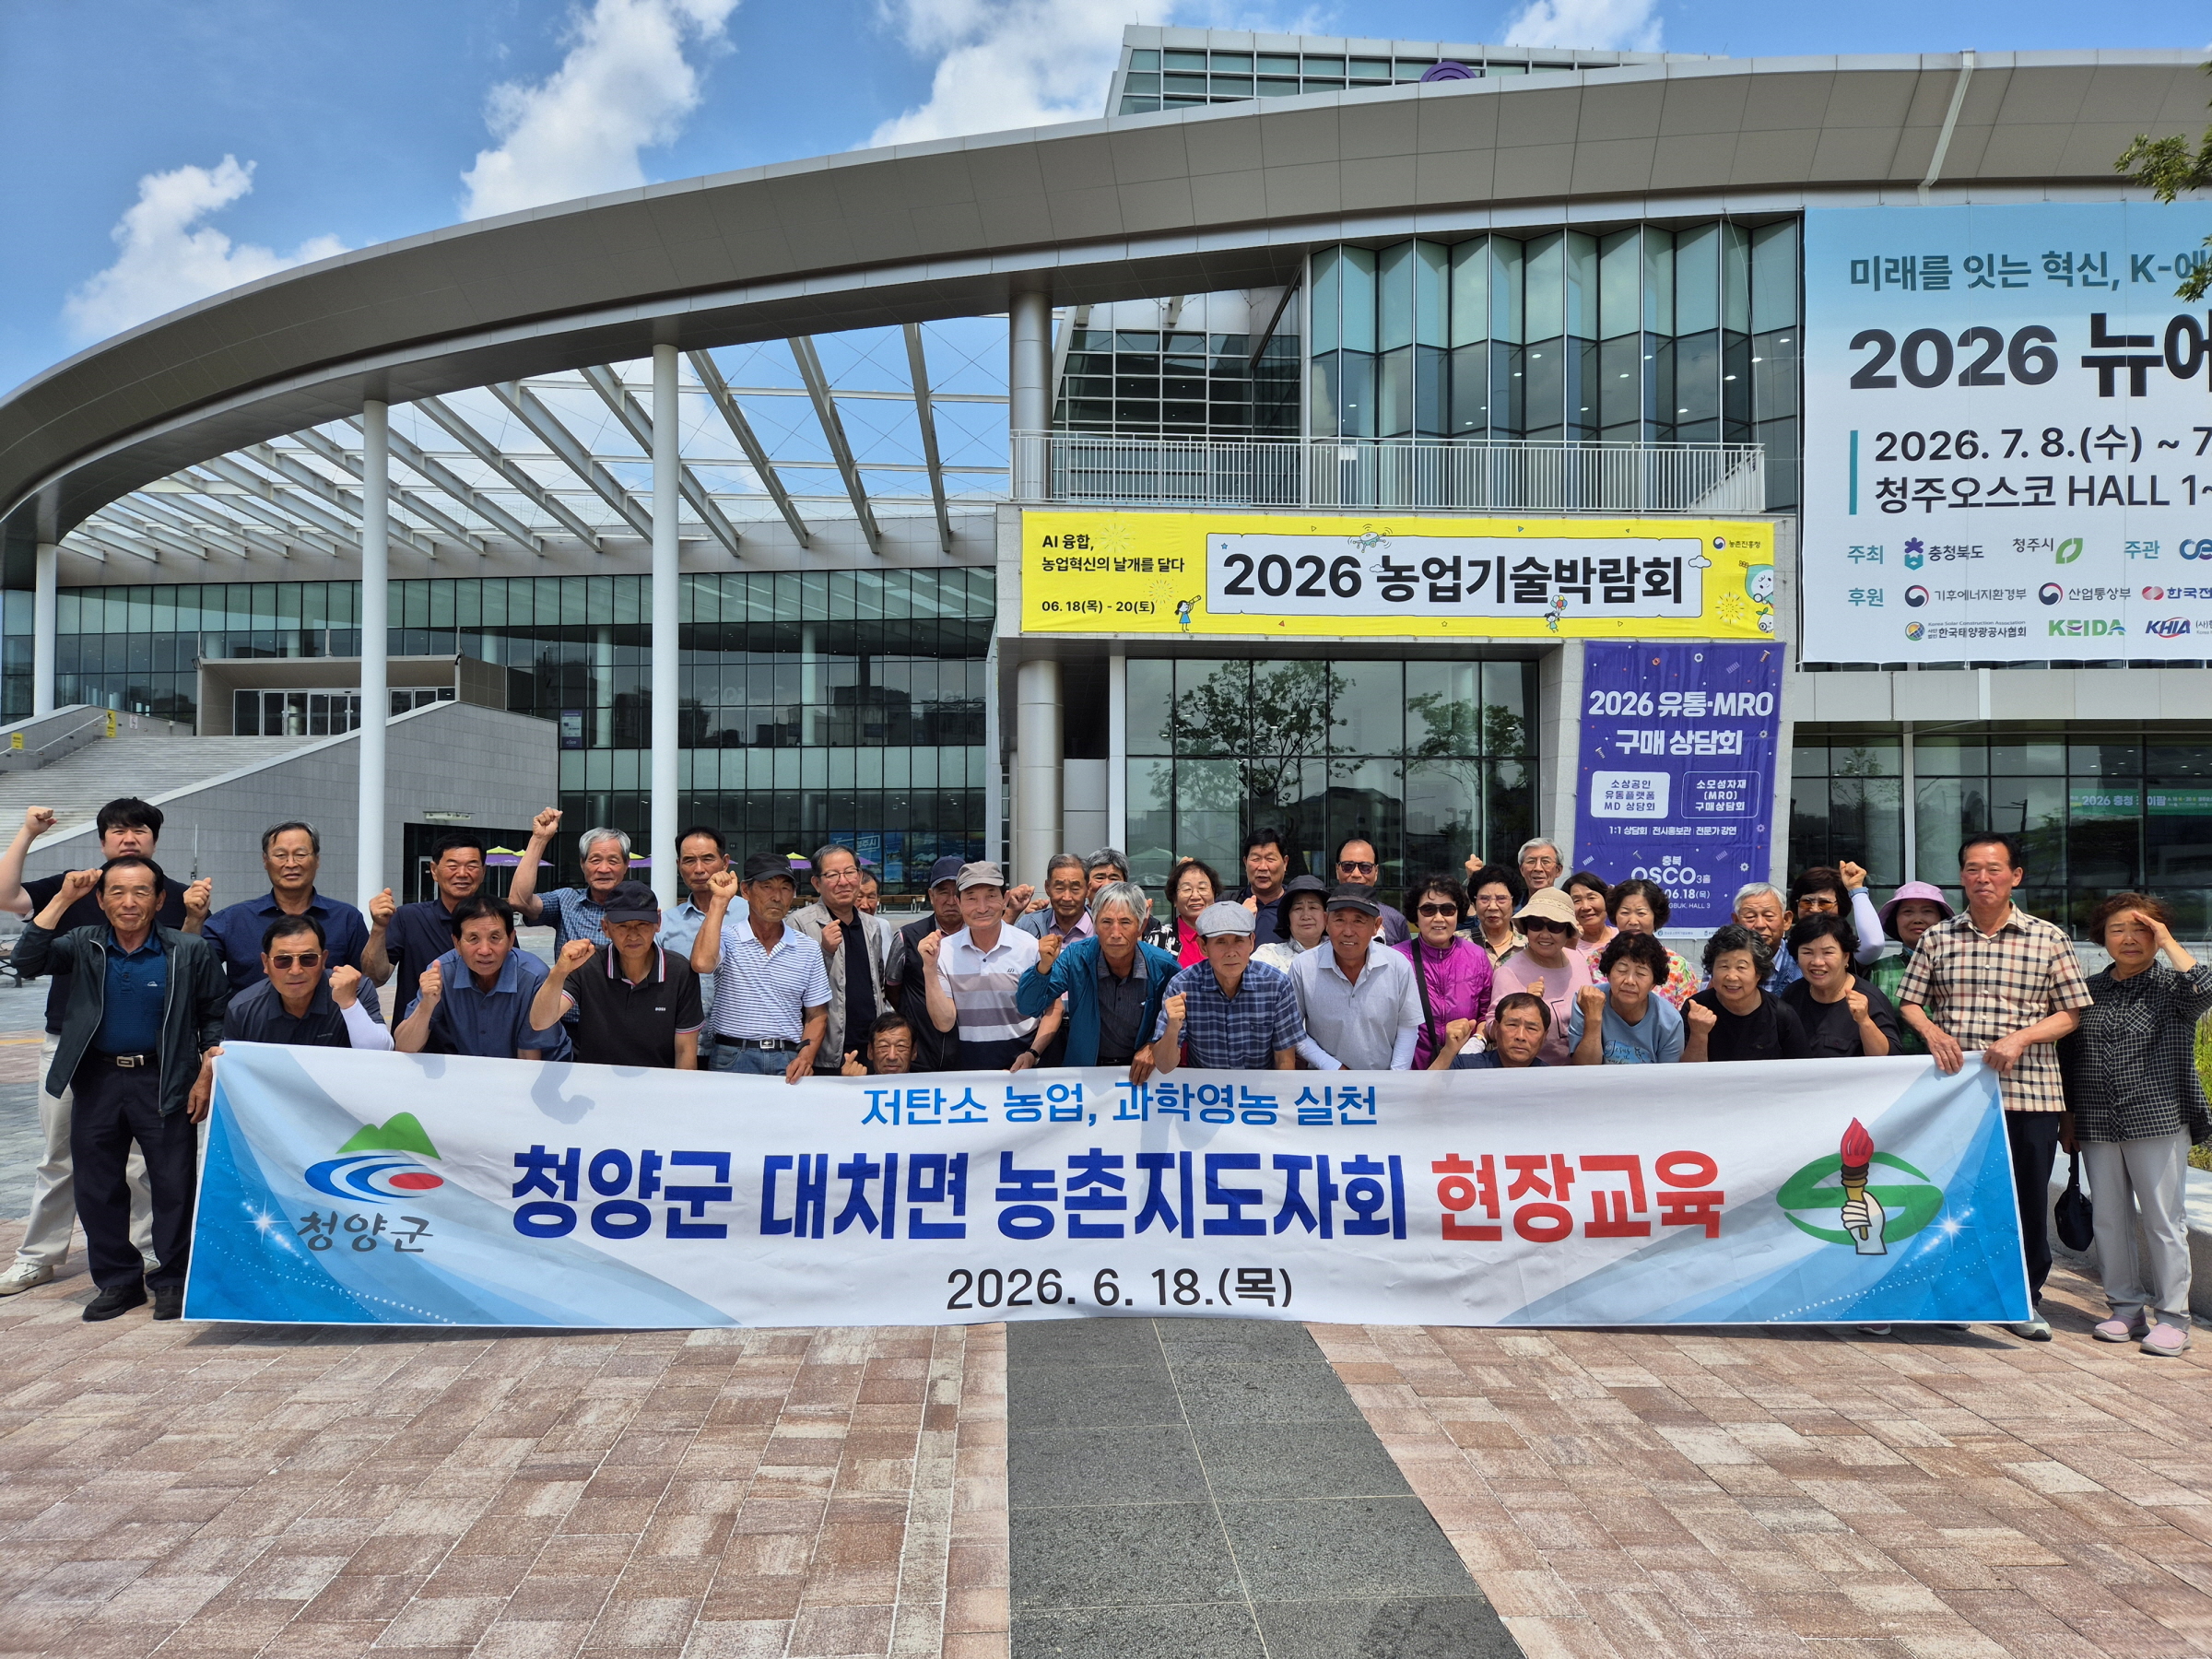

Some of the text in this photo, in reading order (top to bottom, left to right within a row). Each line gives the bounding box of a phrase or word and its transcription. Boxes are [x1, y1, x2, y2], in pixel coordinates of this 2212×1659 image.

[1851, 255, 1953, 291] 미래를
[1963, 253, 2031, 289] 잇는
[2041, 251, 2120, 291] 혁신,
[1849, 325, 2058, 390] 2026
[1875, 429, 1989, 462] 2026.
[2000, 429, 2029, 458] 7.
[2041, 424, 2142, 464] 8.(수)
[1875, 475, 2056, 514] 청주오스코
[2068, 475, 2170, 506] HALL
[1042, 535, 1094, 551] AI 융합,
[1729, 540, 1761, 548] 농촌진흥청
[2012, 537, 2053, 553] 청주시
[2124, 540, 2160, 559] 주관
[1848, 545, 1884, 564] 주최
[1928, 545, 1984, 561] 충청북도
[1042, 557, 1185, 572] 농업혁신의 날개를 달다
[1224, 553, 1682, 605] 2026 농업기술박람회
[1848, 587, 1884, 607] 후원
[1935, 588, 2027, 602] 기후에너지환경부
[2068, 587, 2132, 601] 산업통상부
[1042, 601, 1063, 612] 06.
[1065, 600, 1103, 614] 18(목)
[1115, 601, 1155, 615] 20(토)
[1938, 626, 2027, 639] 한국태양광공사협회
[2048, 618, 2126, 637] KEIDA
[2145, 620, 2192, 634] KHIA
[1588, 690, 1653, 716] 2026
[1616, 730, 1743, 756] 구매 상담회
[1611, 780, 1651, 789] 소상공인
[1696, 779, 1747, 789] 소모성자재
[1605, 791, 1655, 800] 유통플랫폼
[2082, 795, 2111, 806] 2026
[1605, 802, 1655, 811] MD 상담회
[1695, 802, 1745, 812] 구매상담회
[1609, 826, 1621, 834] 1:1
[1624, 827, 1648, 835] 상담회
[1653, 827, 1691, 835] 전시홍보관
[1662, 855, 1681, 866] 충북
[1631, 866, 1696, 885] OSCO
[1665, 888, 1711, 899] 06.18(목)
[861, 1080, 1378, 1127] 저탄소 농업, 과학영농 실천
[512, 1144, 1724, 1242] 청양군 대치면 농촌지도자회 현장교육
[298, 1211, 433, 1253] 청양군
[947, 1265, 1292, 1310] 2026. 6. 18.(목)
